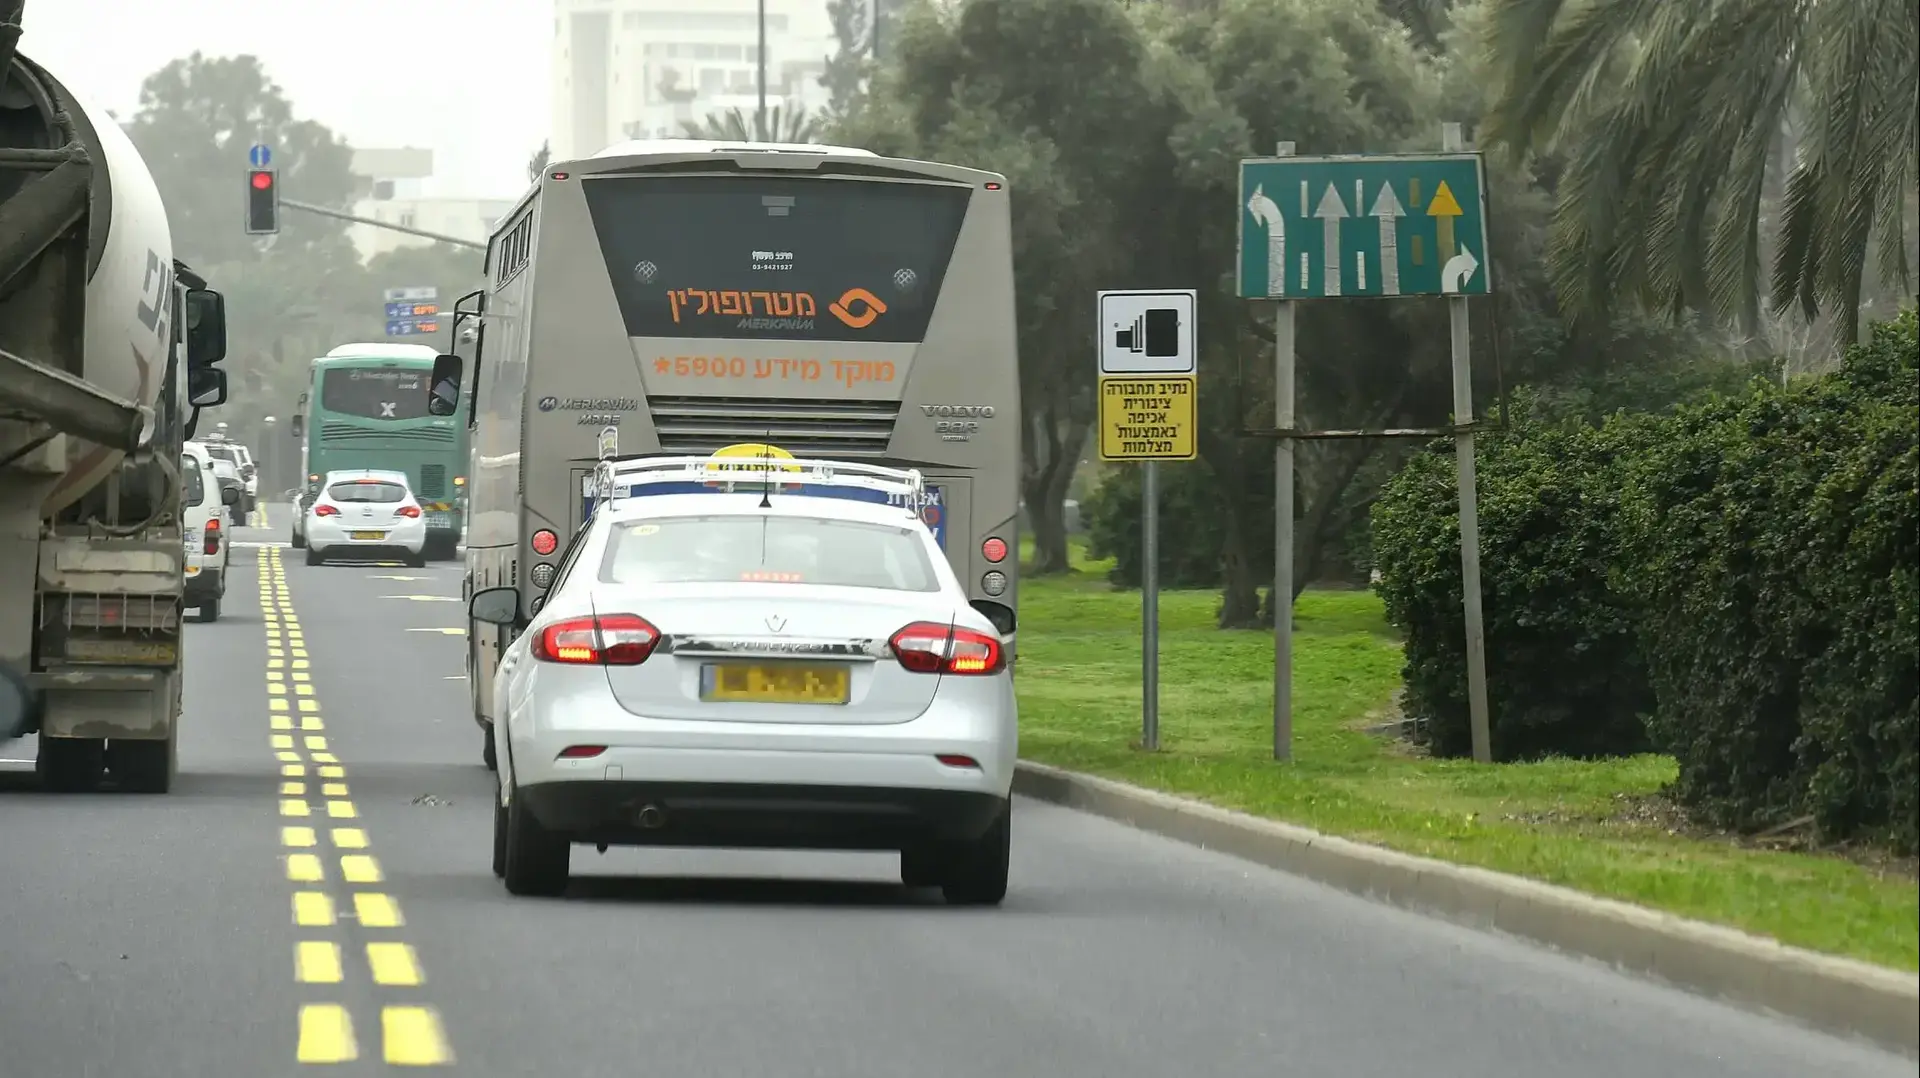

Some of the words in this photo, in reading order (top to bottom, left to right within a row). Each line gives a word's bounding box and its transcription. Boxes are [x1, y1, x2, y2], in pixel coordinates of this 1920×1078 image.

[667, 288, 816, 324] מטרופולין
[753, 359, 821, 381] מידע
[830, 359, 896, 388] מוקד
[1106, 383, 1156, 396] תחבורה
[1158, 383, 1188, 395] נתיב
[1123, 397, 1171, 410] ציבורית
[920, 404, 996, 419] VOLVO
[1128, 412, 1167, 424] אכיפה
[1122, 439, 1173, 453] מצלמות
